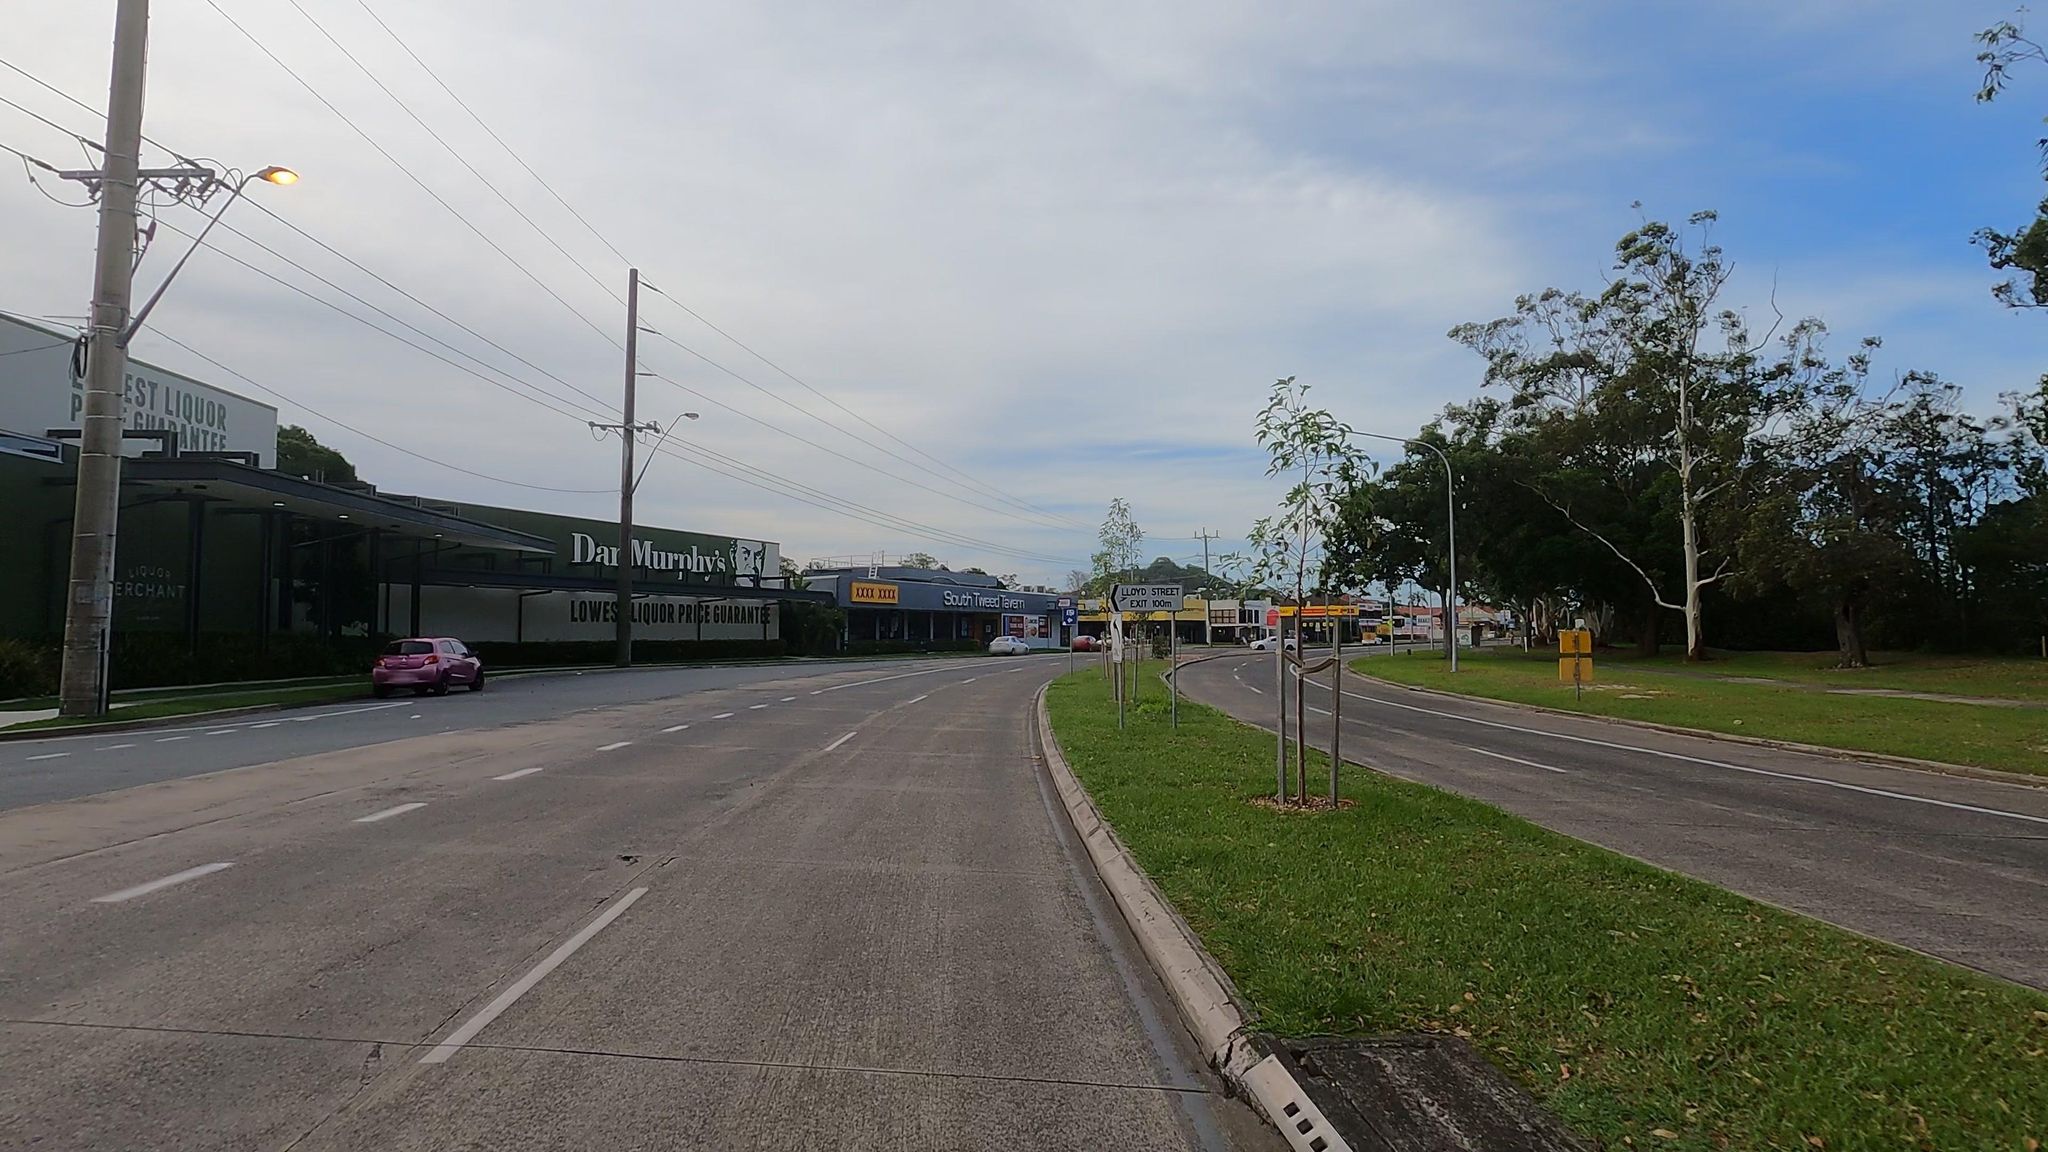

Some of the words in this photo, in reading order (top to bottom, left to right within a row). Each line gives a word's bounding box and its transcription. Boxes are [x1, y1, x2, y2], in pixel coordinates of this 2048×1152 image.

[165, 386, 227, 433] LIQUOR
[631, 538, 727, 582] Murphy's
[115, 581, 187, 599] ERCHANT
[856, 587, 875, 599] XXXX
[878, 588, 896, 600] XXXX
[1121, 587, 1147, 597] LLOYD
[1151, 587, 1180, 596] STREET
[943, 590, 973, 607] South
[973, 592, 1000, 608] Tweed
[1000, 594, 1026, 609] Tavern
[1130, 599, 1148, 608] EXIT
[1152, 599, 1172, 608] 100m
[570, 599, 618, 623] LOWES
[631, 602, 675, 625] LIQUOR
[678, 603, 711, 624] PRICE
[713, 604, 771, 625] GUARANTEE
